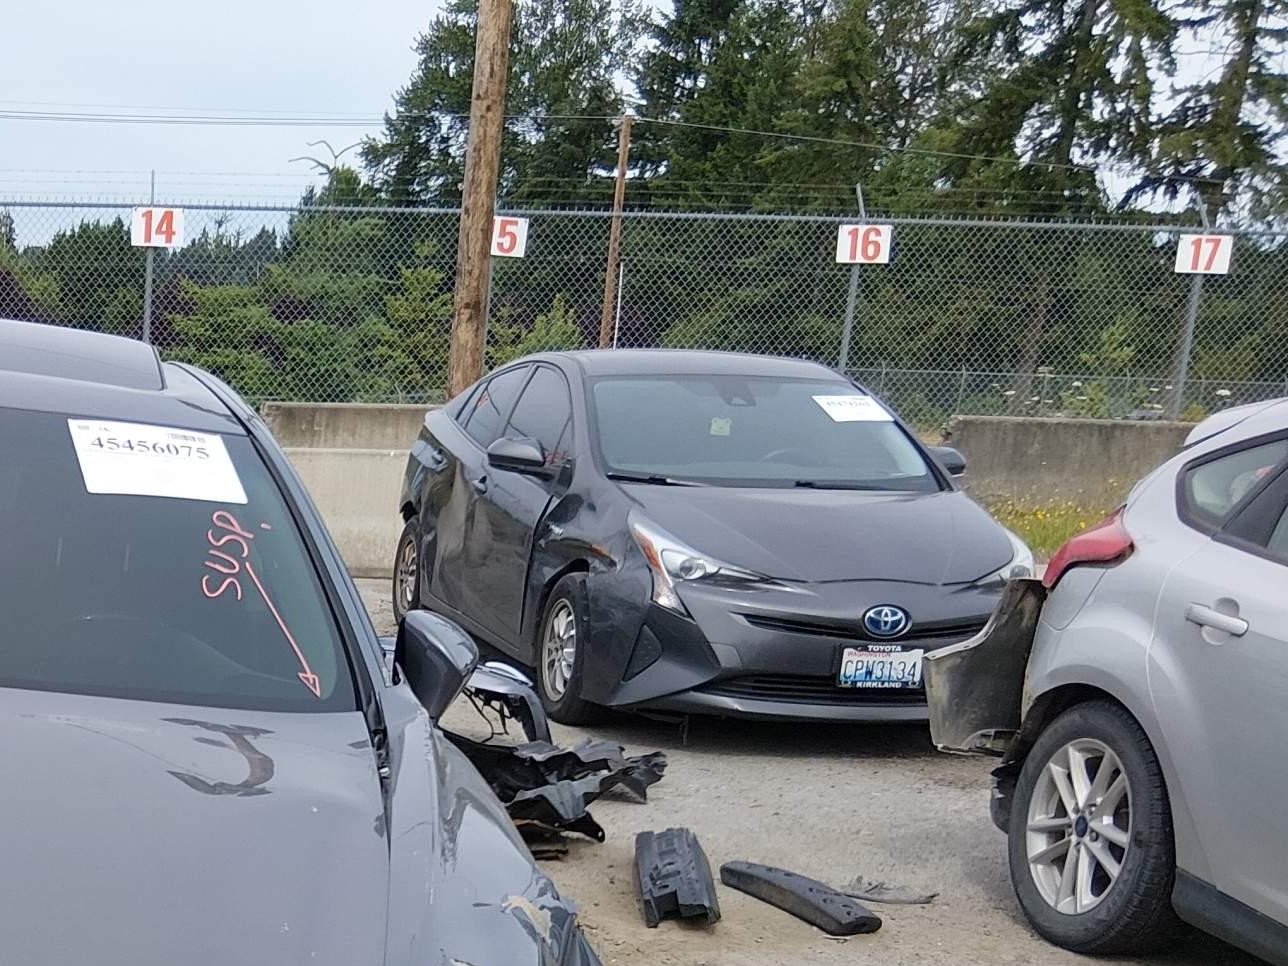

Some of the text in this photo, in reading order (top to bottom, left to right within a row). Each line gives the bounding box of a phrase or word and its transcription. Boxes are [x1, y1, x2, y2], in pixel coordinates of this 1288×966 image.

[142, 210, 176, 244] 14
[493, 219, 519, 254] 5
[847, 227, 882, 262] 16
[1190, 237, 1222, 271] 17
[90, 436, 211, 460] 45456075
[867, 644, 902, 652] TOYOTA
[843, 659, 917, 681] CPW3134
[856, 681, 903, 689] KIRKLAND
